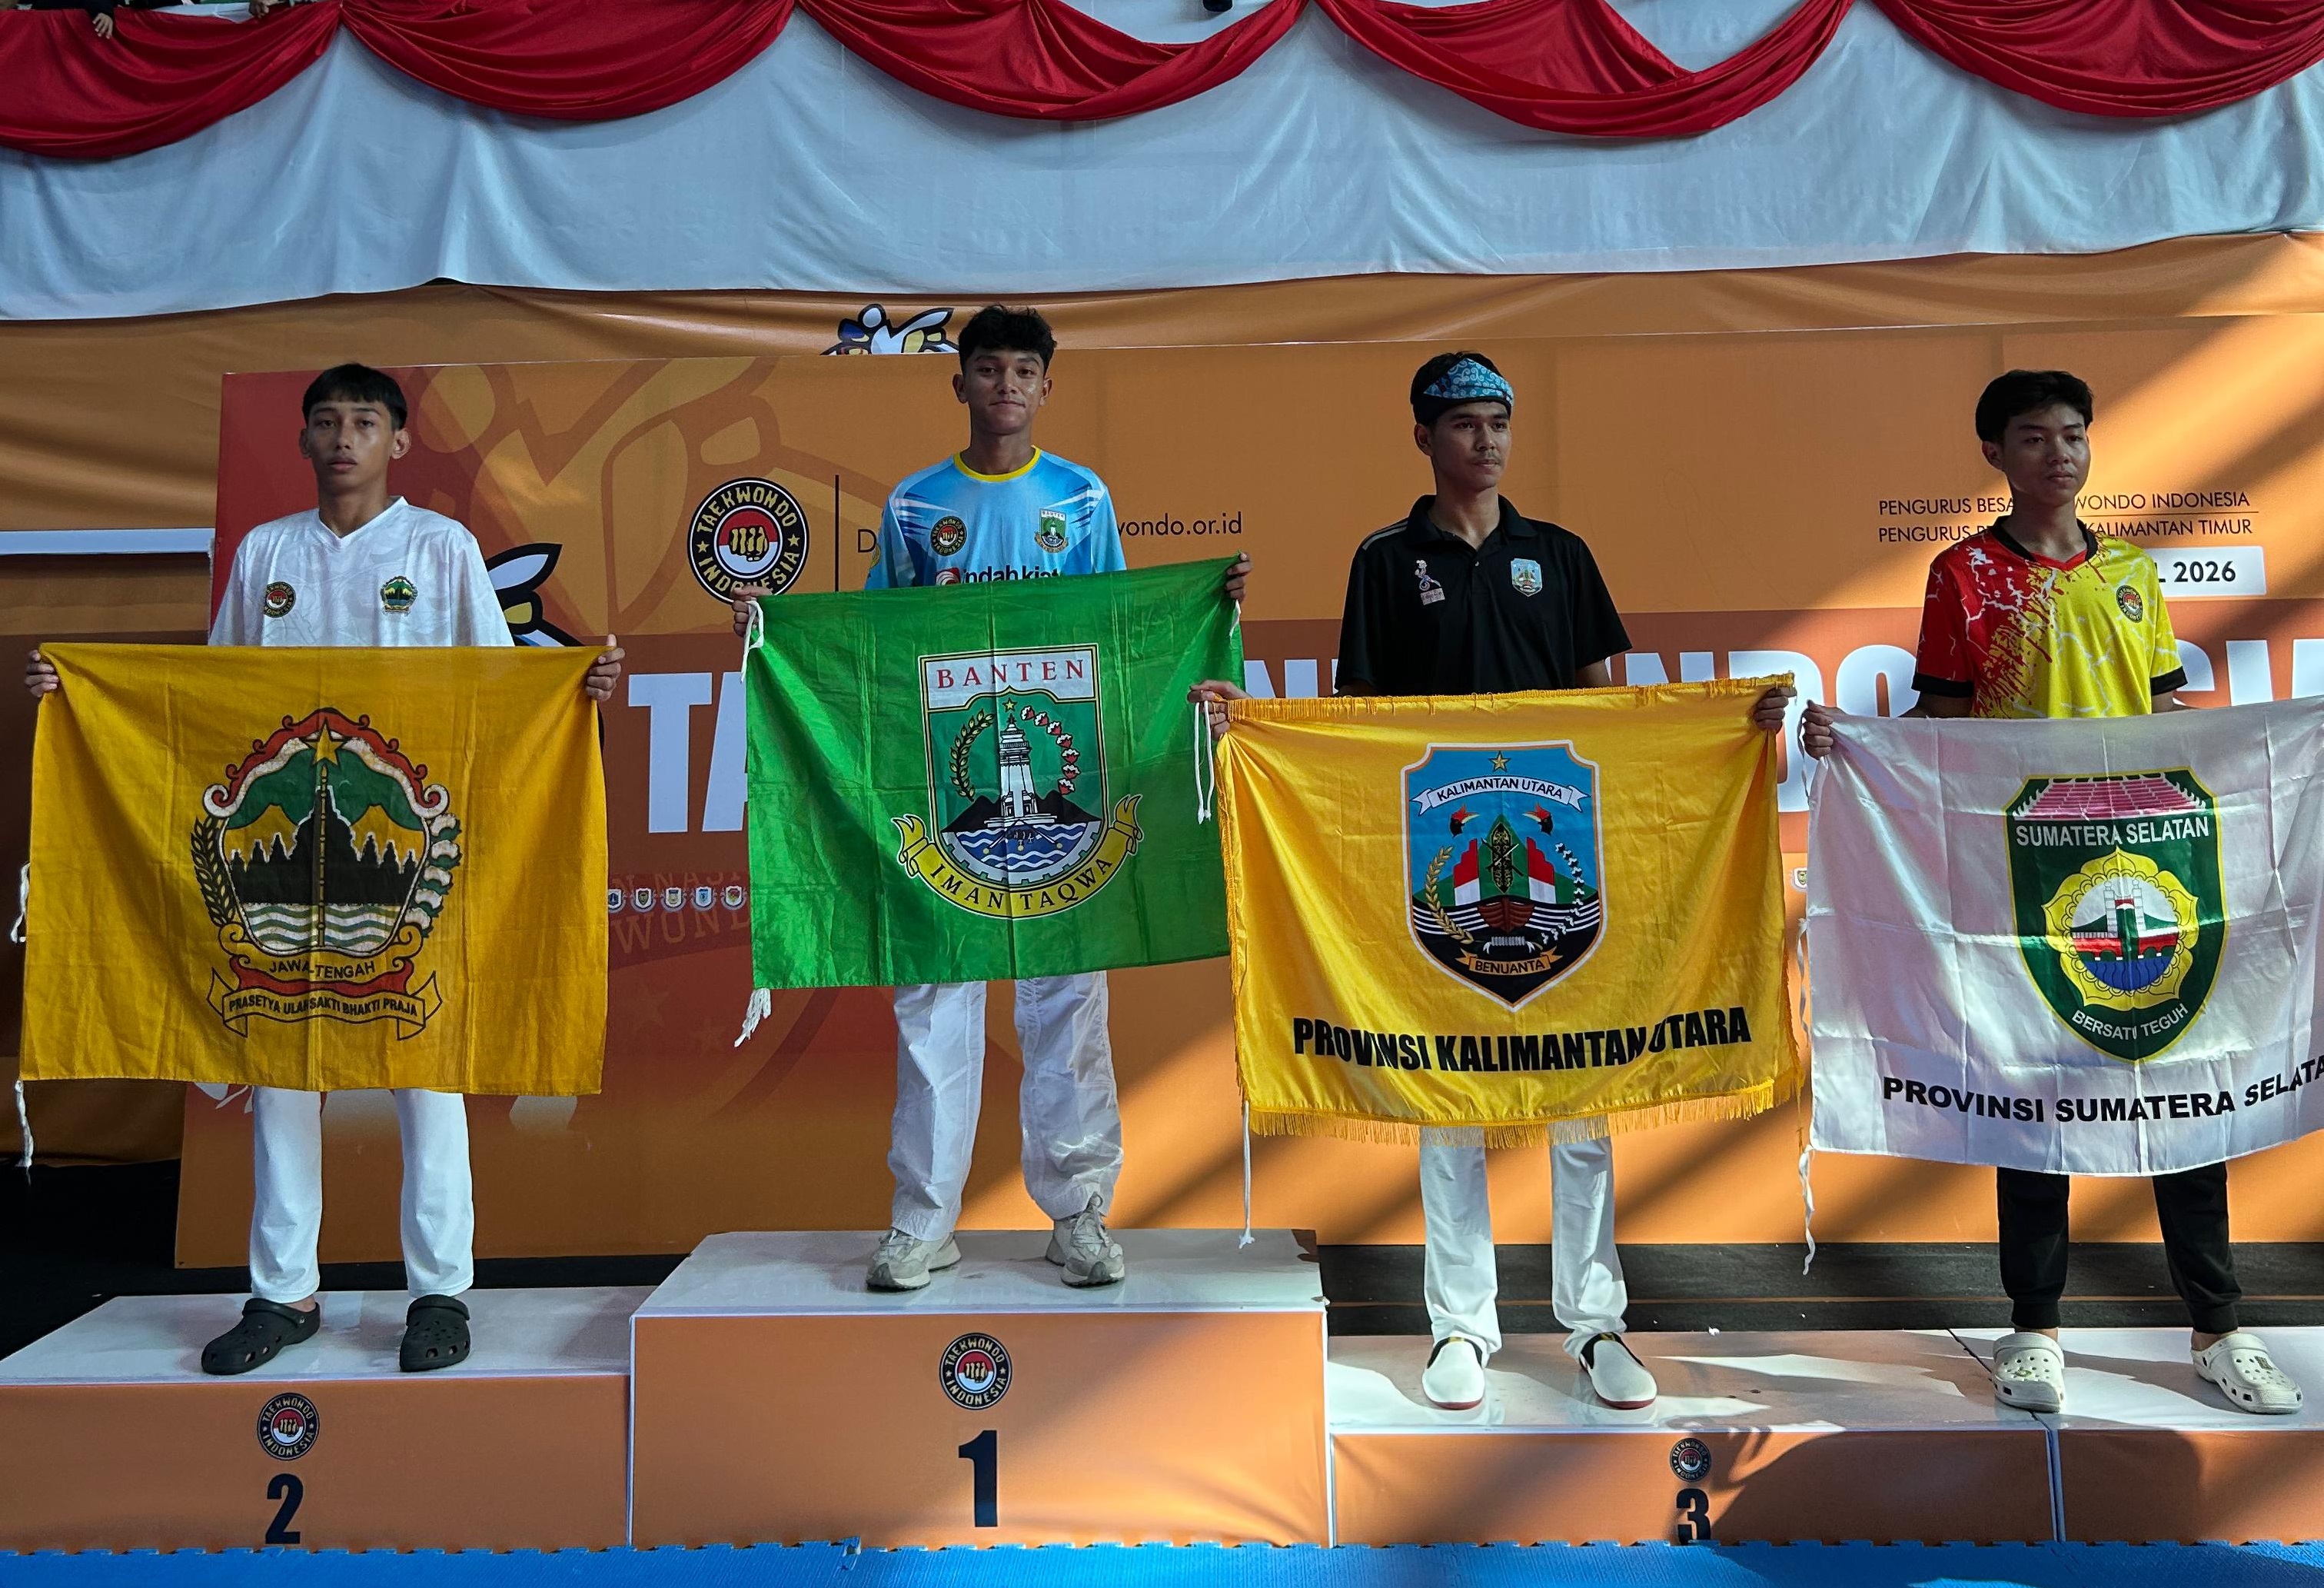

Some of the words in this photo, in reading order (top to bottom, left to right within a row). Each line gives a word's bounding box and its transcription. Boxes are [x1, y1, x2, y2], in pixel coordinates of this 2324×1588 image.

[697, 485, 798, 533] TAEKWONDO
[1879, 498, 1972, 515] PENGURUS
[1977, 497, 2013, 513] BESA
[2075, 494, 2146, 511] WONDO
[2152, 491, 2250, 509] INDONESIA
[1878, 525, 1971, 542] PENGURUS
[2198, 518, 2253, 534] TIMUR
[698, 551, 800, 592] INDOESIA
[963, 564, 1019, 583] ndah
[2173, 561, 2236, 583] 2026
[936, 659, 1083, 689] BANTEN
[1437, 777, 1519, 801] KALIMANTAN
[1521, 779, 1563, 800] UTARA
[2016, 824, 2123, 846] SUMATERA
[2126, 817, 2209, 844] SELATAN
[929, 863, 1004, 909] IMAN
[1019, 857, 1113, 911] TAQWA
[1475, 959, 1546, 974] BENUANTA
[229, 994, 281, 1014] PRASETYA
[342, 999, 381, 1016] BHAKTI
[383, 997, 418, 1017] PRAJA
[2072, 1010, 2137, 1040] BERSATU
[2140, 1003, 2189, 1037] TEGUH
[1293, 1017, 1432, 1070] PROVINSI
[1435, 1027, 1647, 1071] KALIMANTAN
[1648, 1007, 1752, 1053] UTARA
[1883, 1077, 2044, 1123] PROVINSI
[2055, 1090, 2236, 1123] SUMATERA
[2243, 1054, 2324, 1107] SELATA
[944, 1337, 1005, 1366] TAEKWONDO
[946, 1377, 1006, 1405] INDONESIA
[261, 1397, 314, 1422] TAEKWONDO
[262, 1432, 314, 1456] INDONESIA
[958, 1430, 998, 1527] 1
[265, 1473, 304, 1544] 2
[1676, 1488, 1711, 1545] 3
